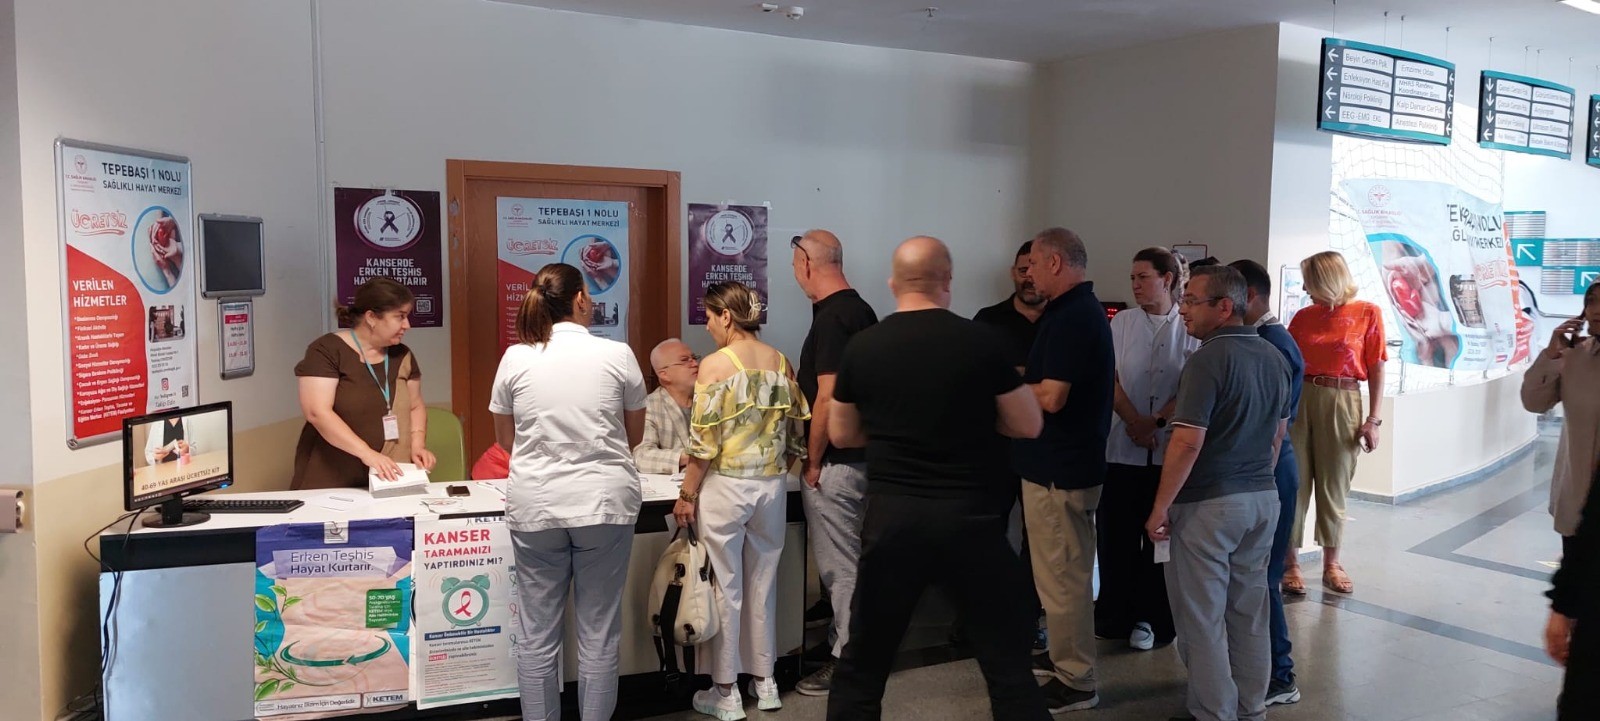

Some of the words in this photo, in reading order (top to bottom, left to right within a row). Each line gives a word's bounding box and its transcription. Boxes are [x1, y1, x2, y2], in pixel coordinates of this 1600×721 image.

[102, 162, 149, 180] TEPEBAŞI
[151, 168, 156, 179] 1
[158, 169, 182, 183] NOLU
[102, 180, 134, 192] SAĞLIKLI
[135, 184, 156, 193] HAYAT
[158, 185, 182, 196] MERKEZİ
[538, 207, 584, 218] TEPEBAŞI
[587, 208, 591, 217] 1
[594, 208, 619, 218] NOLU
[71, 209, 128, 229] ÜCRETSİZ
[537, 217, 568, 226] SAĞLIKLI
[569, 219, 590, 227] HAYAT
[591, 219, 620, 228] MERKEZİ
[506, 238, 559, 253] ÜCRETSİZ
[366, 258, 414, 268] KANSERDE
[711, 264, 747, 273] KANSERDE
[358, 267, 389, 276] ERKEN
[705, 272, 728, 280] ERKEN
[72, 277, 114, 291] VERİLEN
[506, 282, 531, 292] VERİL
[73, 294, 127, 308] HİZMETLER
[141, 482, 157, 491] 40-69
[424, 529, 491, 546] KANSER
[290, 552, 329, 563] Erken
[332, 550, 375, 563] Teşhis
[424, 545, 491, 559] TARAMANIZI
[290, 564, 325, 575] Hayat
[328, 563, 375, 573] Kurtarır.
[424, 558, 484, 571] YAPTIRDINIZ
[486, 556, 503, 566] MI?
[372, 694, 403, 702] KETEM
